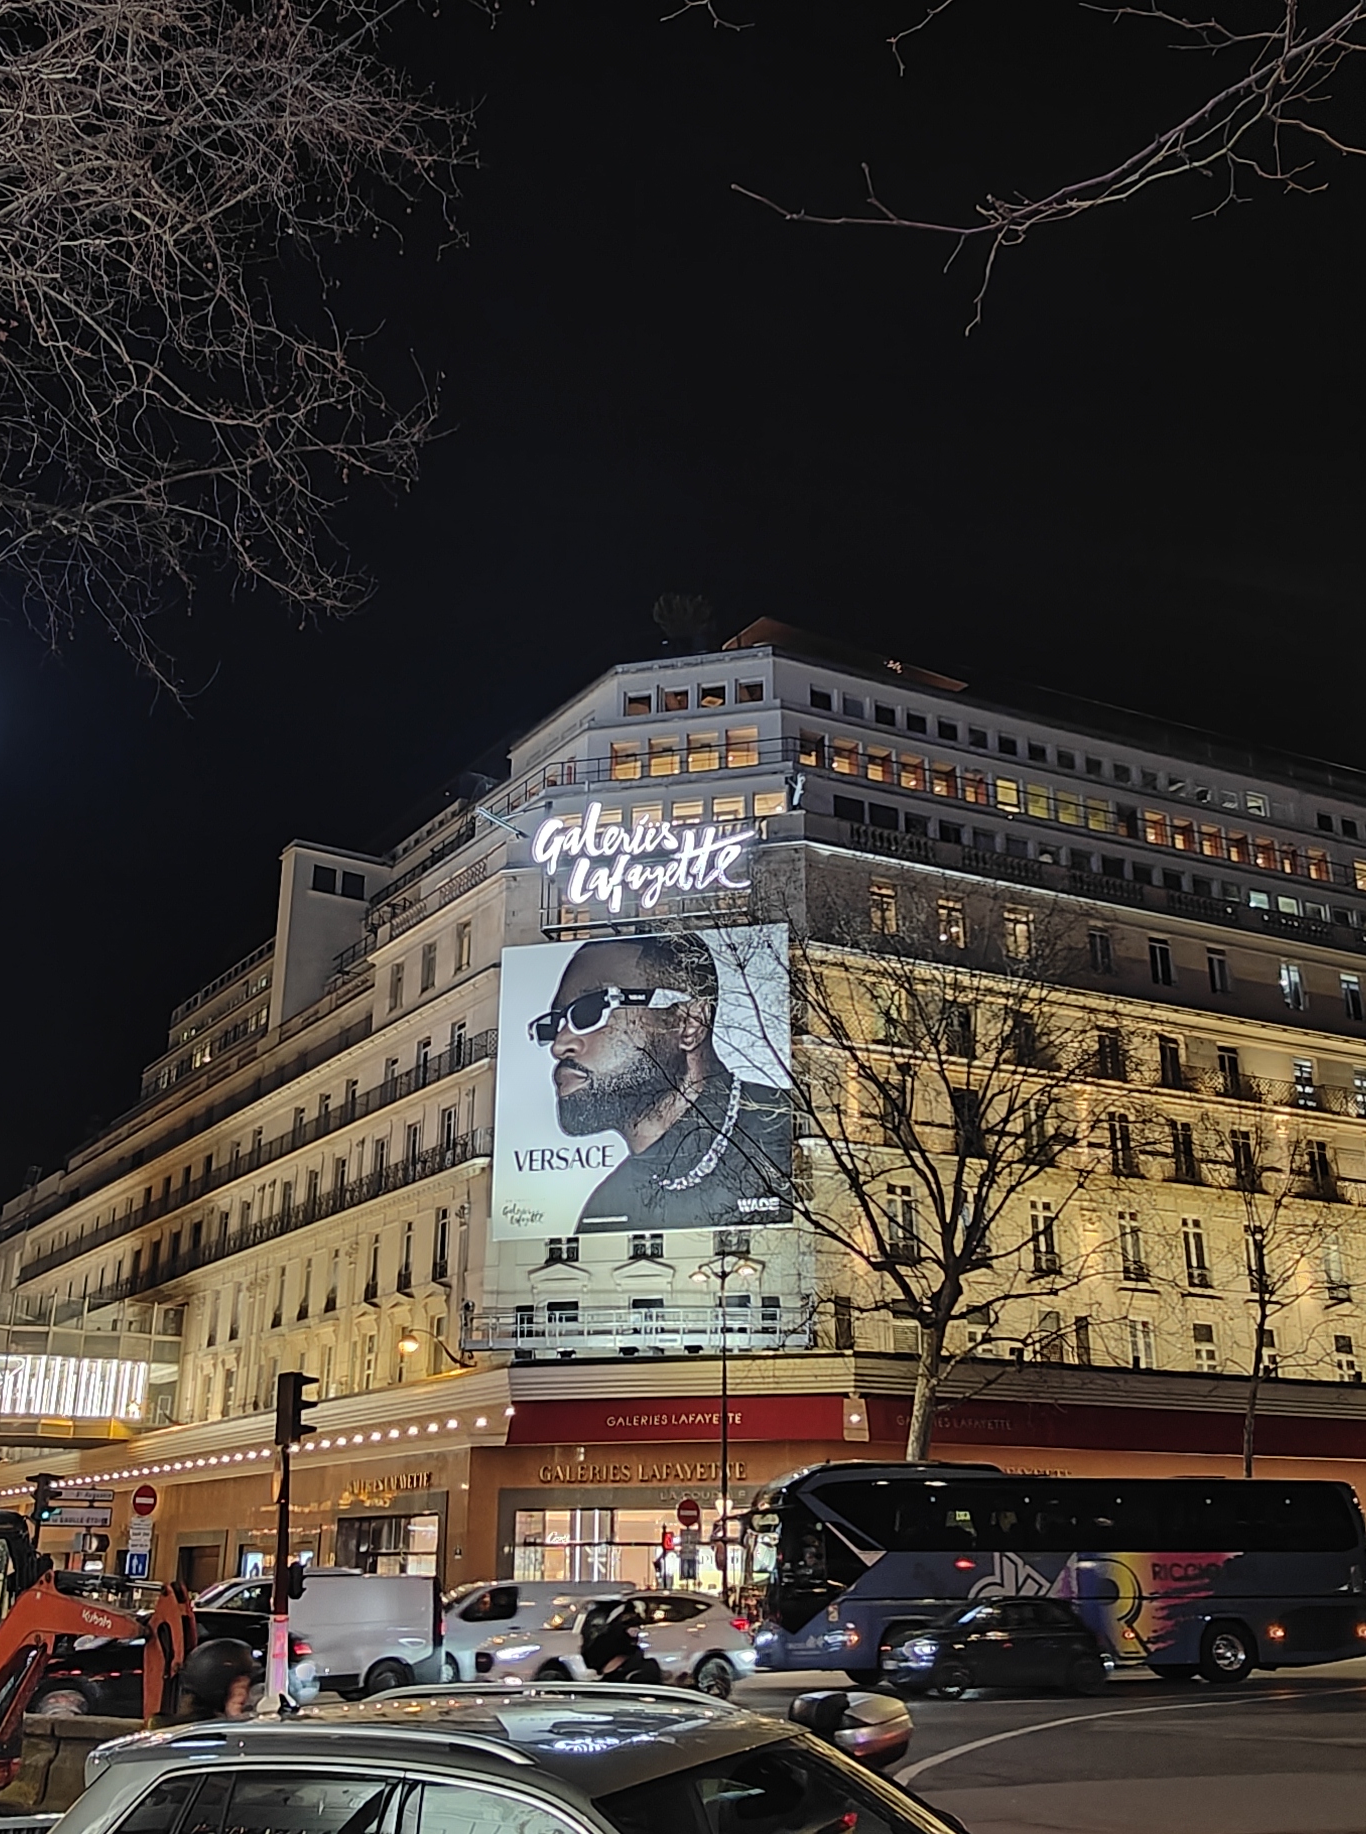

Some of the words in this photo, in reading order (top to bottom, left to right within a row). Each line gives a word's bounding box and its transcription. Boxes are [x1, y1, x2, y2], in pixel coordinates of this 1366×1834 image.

[532, 801, 678, 875] Galeries
[567, 826, 755, 913] Lafayette
[514, 1144, 615, 1172] VERSACE
[737, 1196, 781, 1213] WADE
[606, 1414, 668, 1427] GALERIES
[672, 1412, 742, 1425] LAFAYETTE
[896, 1414, 951, 1429] GAIES
[539, 1463, 633, 1484] GALERIES
[638, 1461, 748, 1481] LAFAYETTE
[660, 1490, 677, 1500] LA
[683, 1490, 746, 1501] COUPLE
[82, 1609, 112, 1630] Kubota
